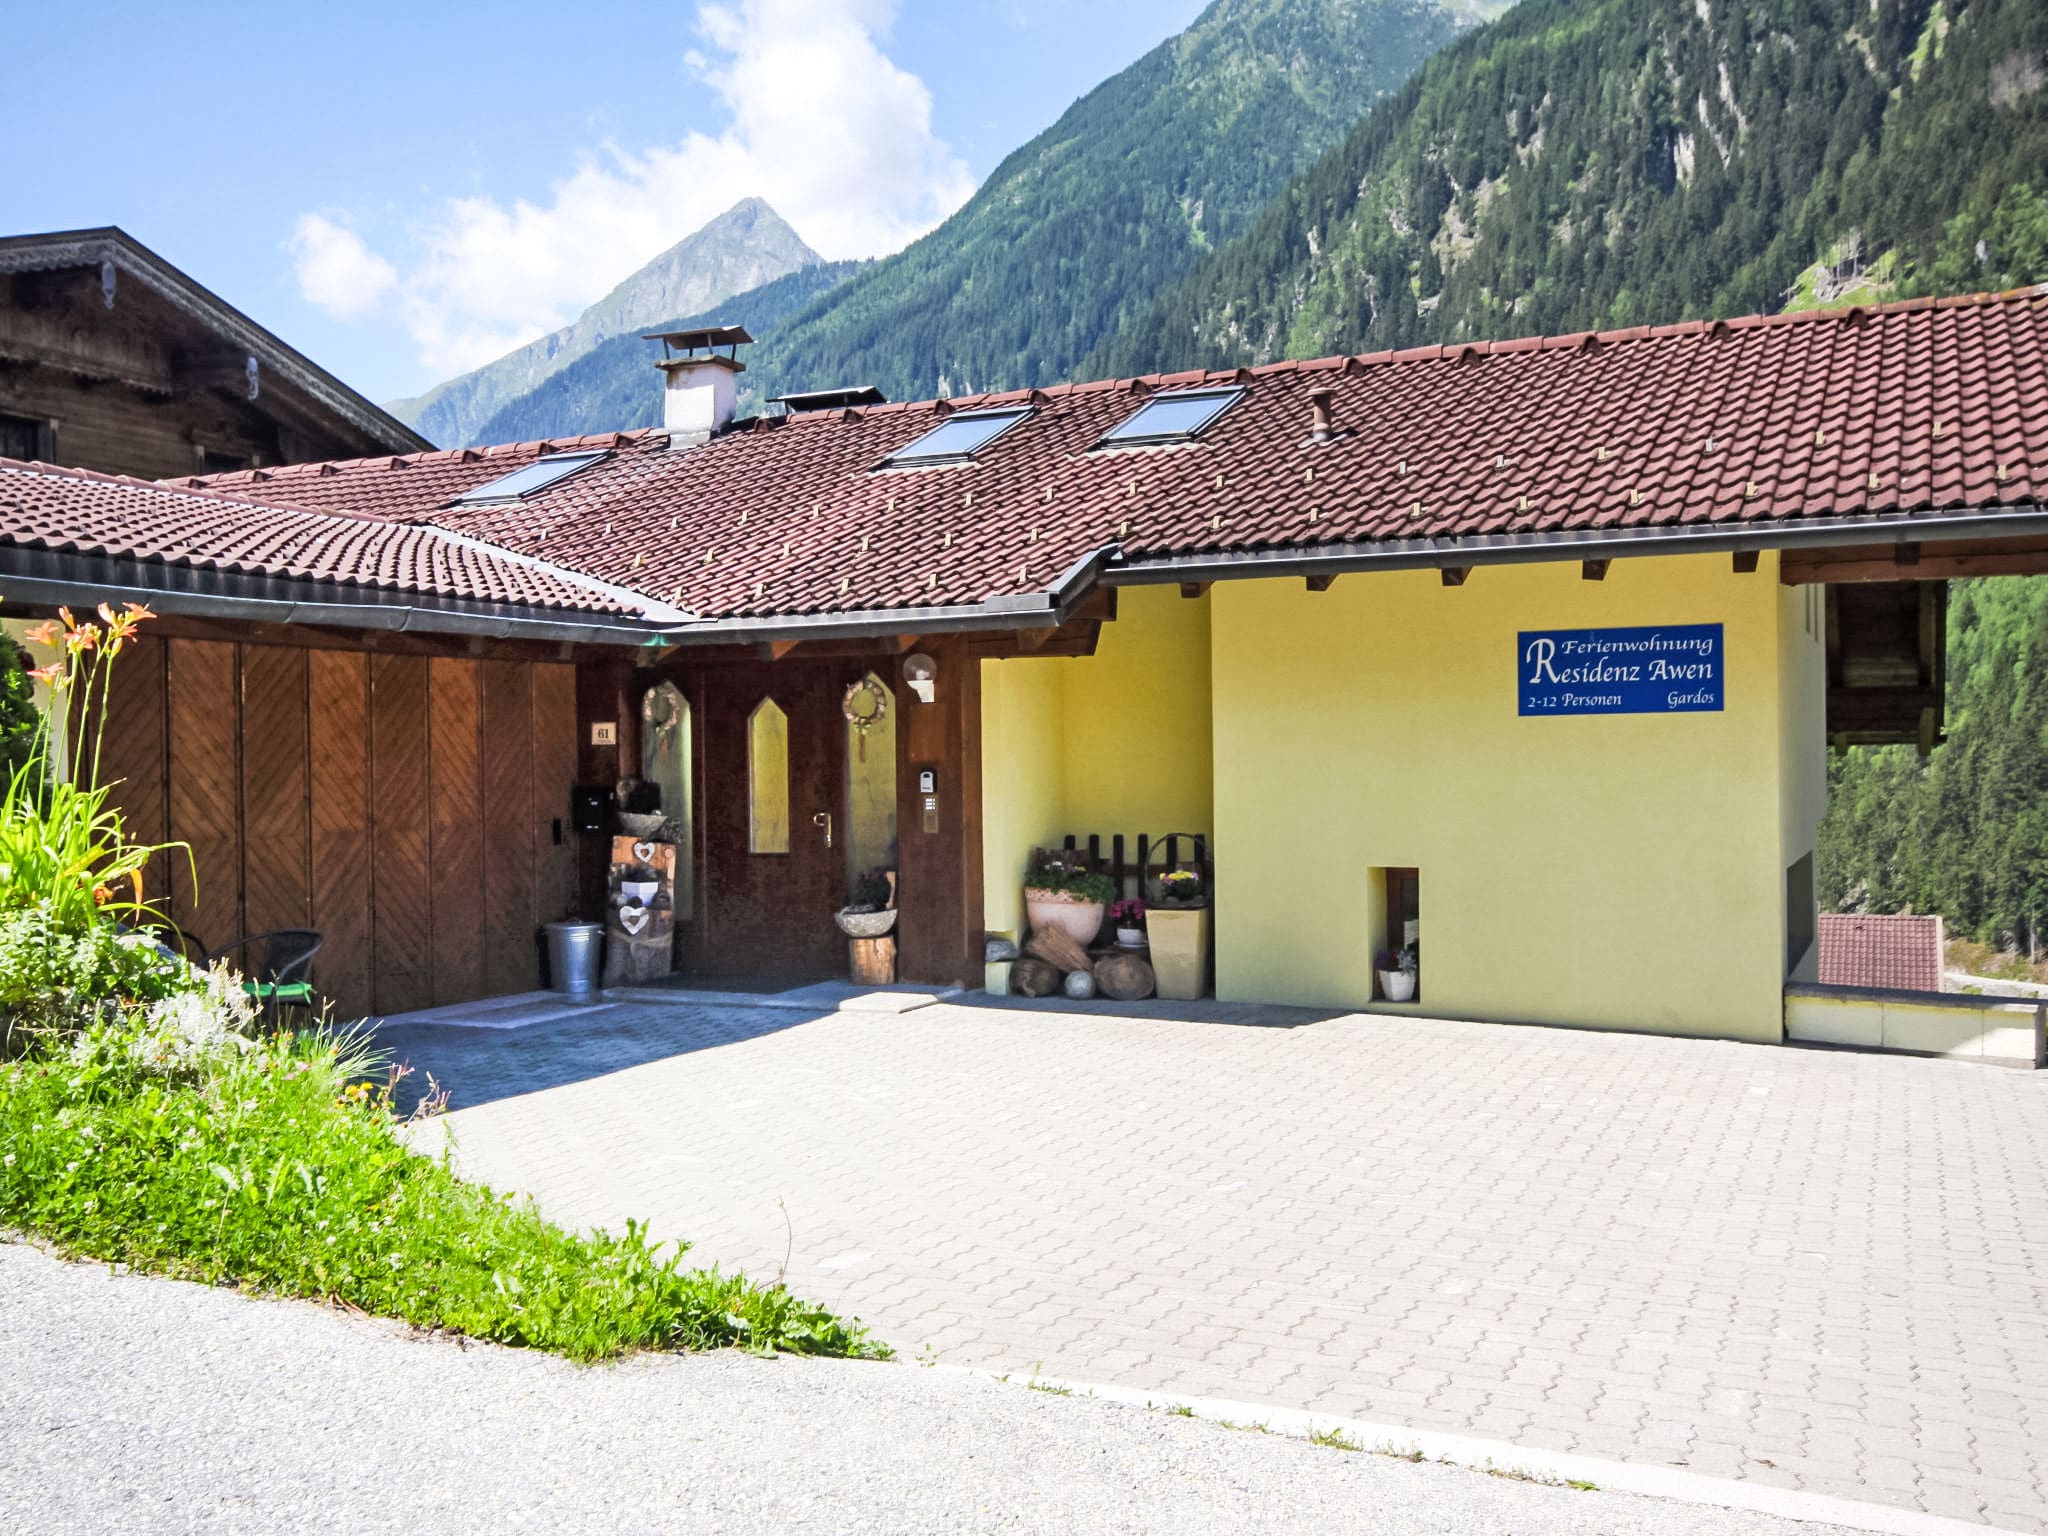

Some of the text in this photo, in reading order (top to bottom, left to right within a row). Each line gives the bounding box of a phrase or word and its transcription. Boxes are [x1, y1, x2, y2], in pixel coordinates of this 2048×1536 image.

[1561, 634, 1713, 656] Ferienwohnung
[1526, 638, 1713, 684] Residenz Awen
[1527, 693, 1622, 708] 2-12 Personen
[1667, 687, 1714, 709] Gardos
[597, 728, 609, 739] 61
